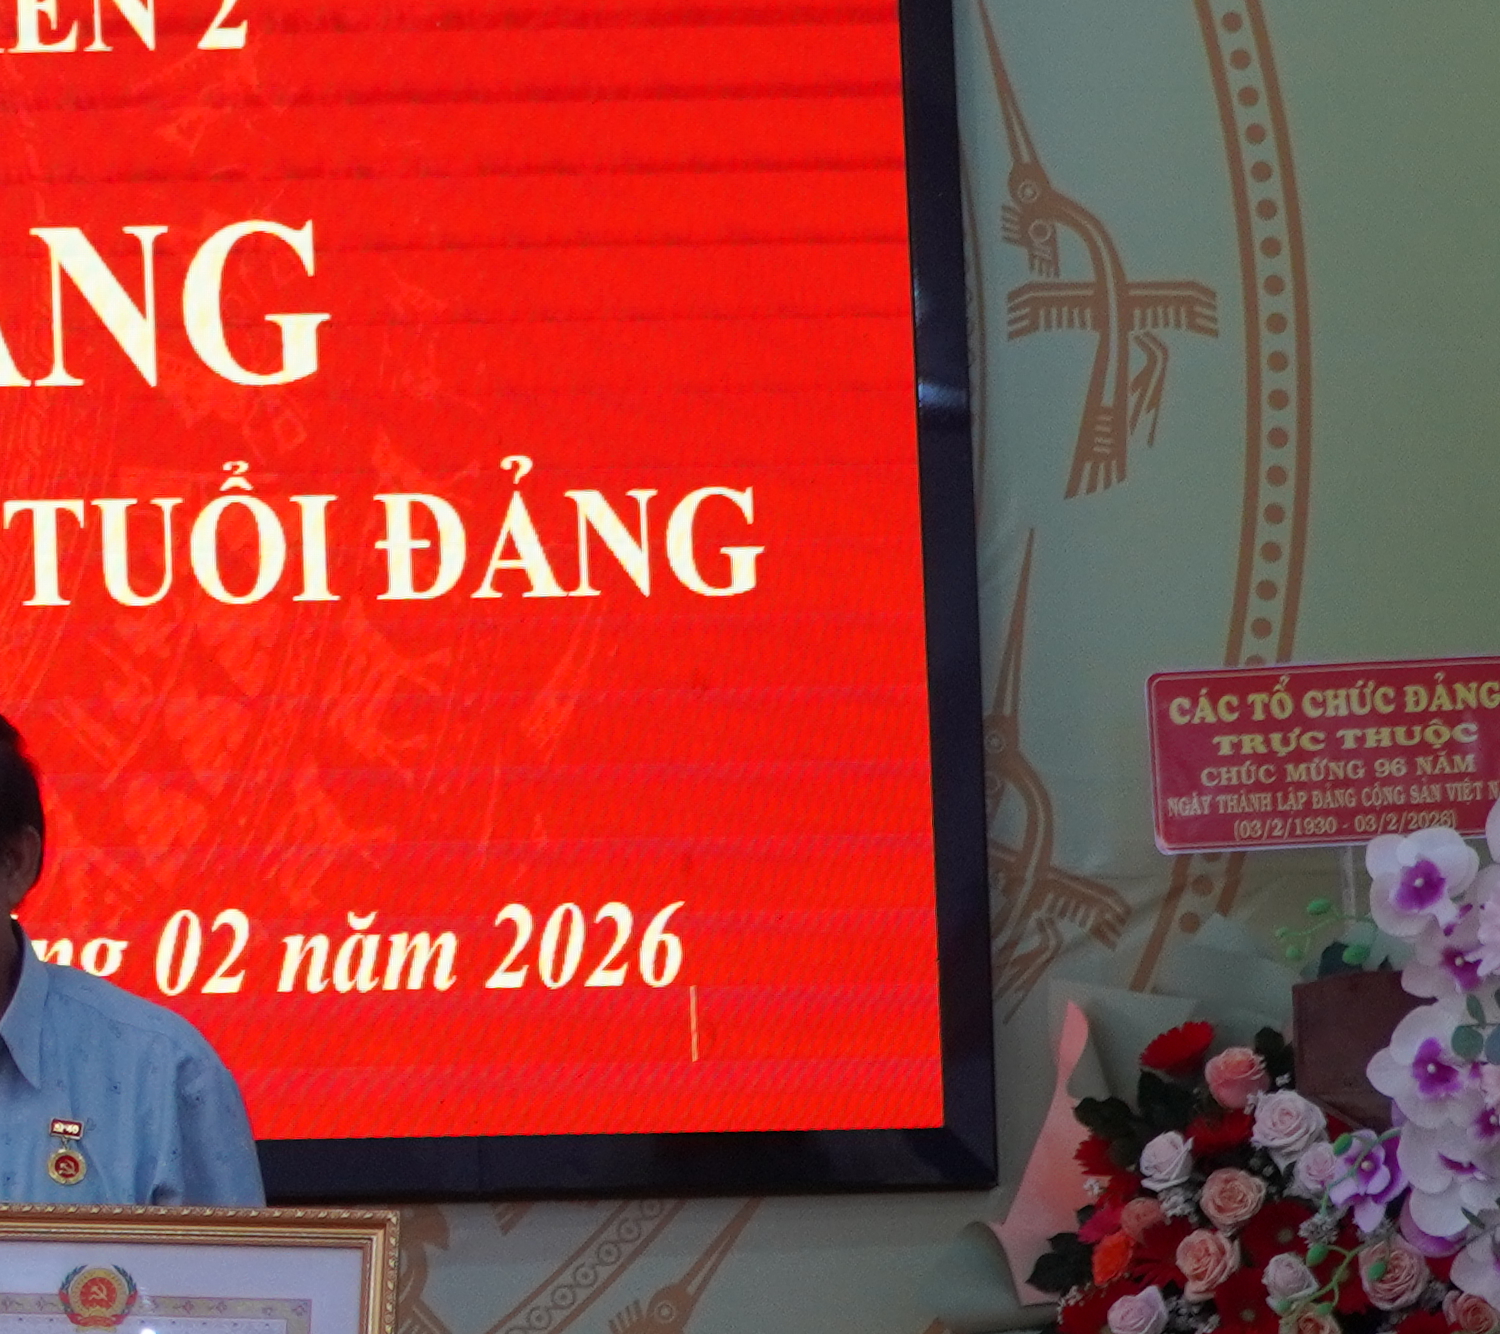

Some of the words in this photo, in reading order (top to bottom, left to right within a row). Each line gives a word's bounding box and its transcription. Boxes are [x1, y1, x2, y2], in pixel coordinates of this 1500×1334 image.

[4, 461, 339, 606] TUỔI
[374, 456, 764, 599] ĐẢNG
[1169, 688, 1239, 725] CÁC
[1248, 675, 1294, 721] TỔ
[1302, 680, 1396, 718] CHỨC
[1403, 672, 1500, 713] ĐẢNG
[1212, 727, 1326, 757] TRỰC
[1336, 718, 1479, 750] THUỘC
[1201, 760, 1277, 786] CHÚC
[1374, 758, 1407, 777] 96
[1415, 750, 1477, 775] NĂM
[156, 909, 249, 996] 02
[278, 912, 457, 993] năm
[488, 902, 683, 989] 2026
